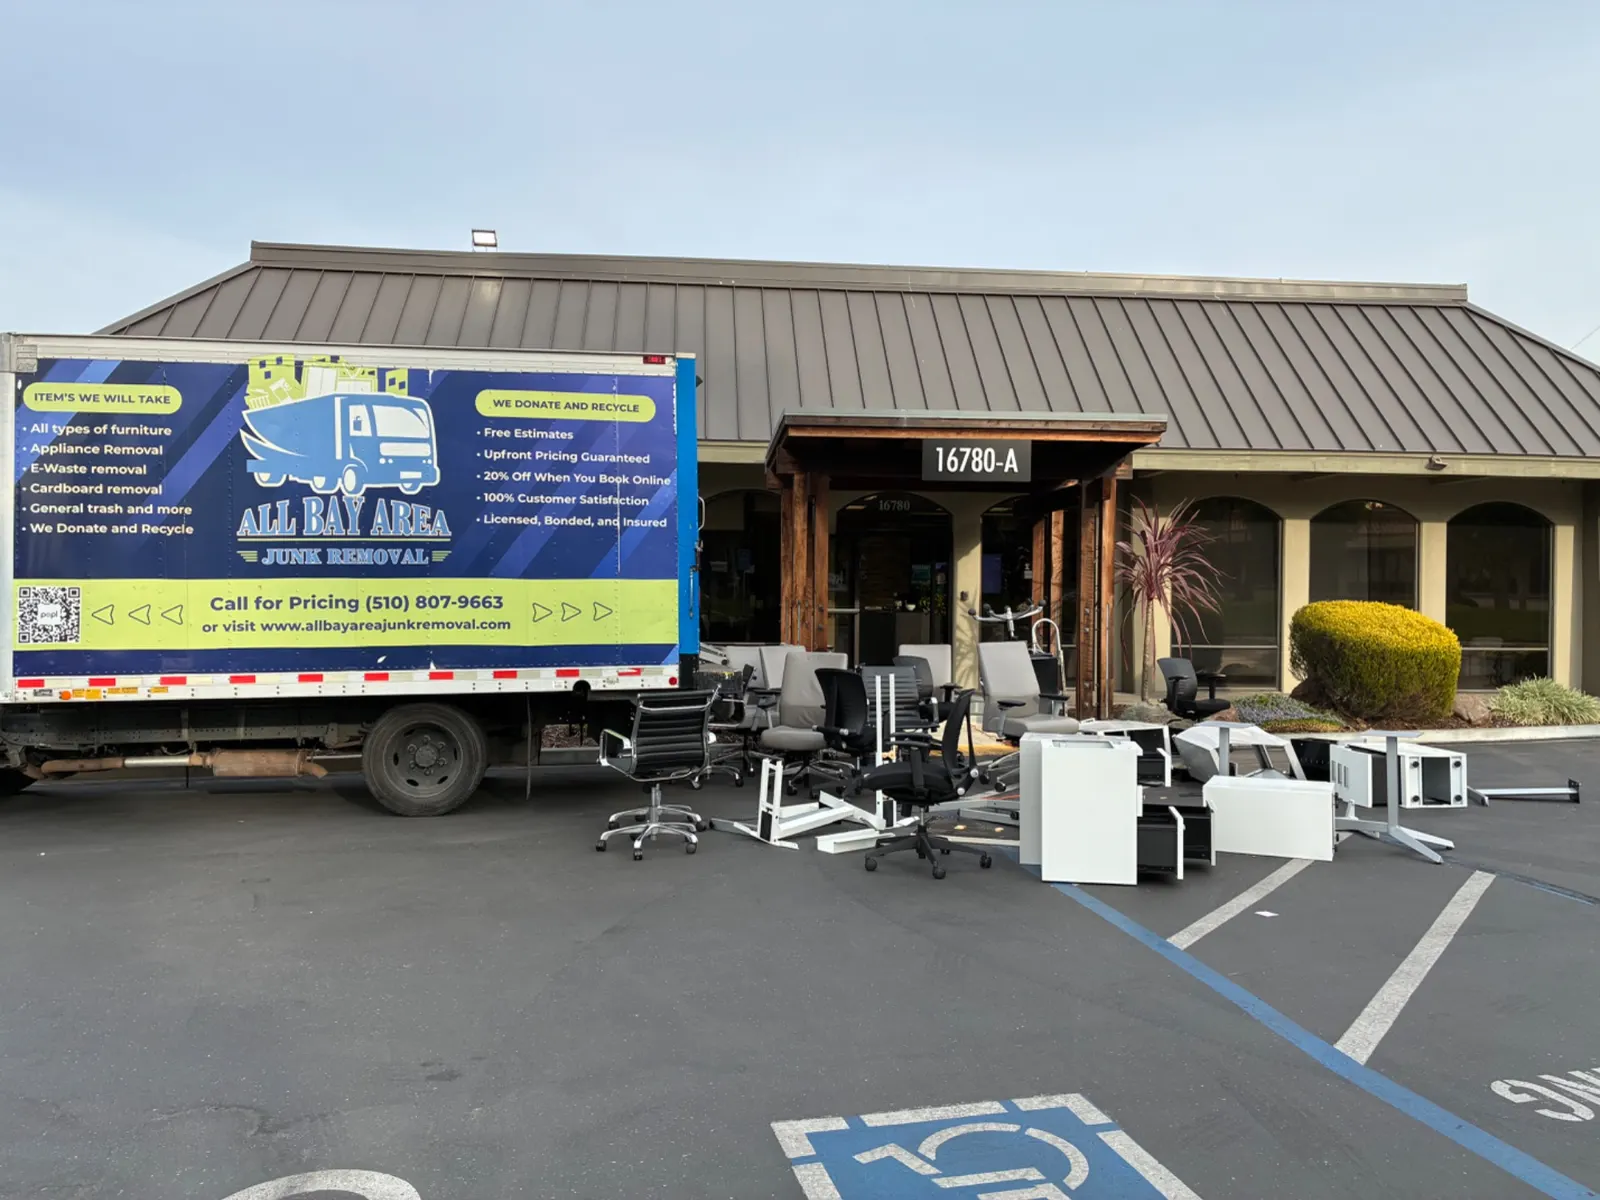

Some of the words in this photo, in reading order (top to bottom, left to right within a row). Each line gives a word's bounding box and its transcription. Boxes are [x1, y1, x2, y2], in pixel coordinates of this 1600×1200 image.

[34, 392, 75, 402] ITEM'S
[78, 393, 100, 403] WE
[103, 394, 135, 403] WILL
[138, 395, 171, 404] TAKE
[493, 399, 512, 408] WE
[515, 400, 561, 410] DONATE
[564, 402, 589, 411] AND
[592, 403, 640, 413] RECYCLE
[30, 423, 48, 434] All
[52, 424, 90, 438] types
[93, 424, 108, 435] of
[111, 424, 172, 436] furniture
[484, 428, 511, 438] Free
[514, 429, 574, 440] Estimates
[30, 443, 100, 456] Appliance
[104, 444, 163, 455] Removal
[484, 449, 532, 461] Upfront
[535, 450, 578, 463] Pricing
[581, 452, 650, 464] Guaranteed
[936, 447, 1018, 473] 16780-A
[31, 463, 87, 474] E-Waste
[91, 464, 147, 475] removal
[484, 471, 509, 481] 20%
[512, 471, 531, 482] Off
[534, 472, 570, 483] When
[573, 474, 596, 484] You
[599, 474, 629, 485] Book
[632, 475, 671, 486] Online
[30, 483, 103, 494] Cardboard
[107, 484, 162, 495] removal
[484, 493, 514, 503] 100%
[518, 493, 576, 505] Customer
[579, 494, 649, 506] Satisfaction
[879, 499, 911, 511] 16780
[30, 503, 84, 514] General
[87, 503, 123, 514] trash
[127, 504, 153, 515] and
[157, 505, 193, 515] more
[237, 499, 296, 536] ALL
[303, 496, 365, 536] BAY
[370, 498, 452, 537] AREA
[484, 514, 541, 526] Licensed,
[544, 515, 594, 527] Bonded,
[597, 516, 620, 527] and
[623, 517, 667, 528] Insured
[30, 523, 53, 534] We
[56, 523, 108, 534] Donate
[111, 524, 138, 534] and
[142, 524, 194, 537] Recycle
[262, 548, 322, 565] JUNK
[327, 548, 429, 565] REMOVAL
[210, 595, 248, 611] Call
[254, 595, 283, 611] for
[289, 594, 360, 613] Pricing
[366, 594, 410, 612] (510)
[415, 594, 504, 610] 807-9663
[202, 622, 218, 633] or
[222, 620, 256, 633] visit
[260, 619, 511, 634] www.allbayareajunkremoval.com
